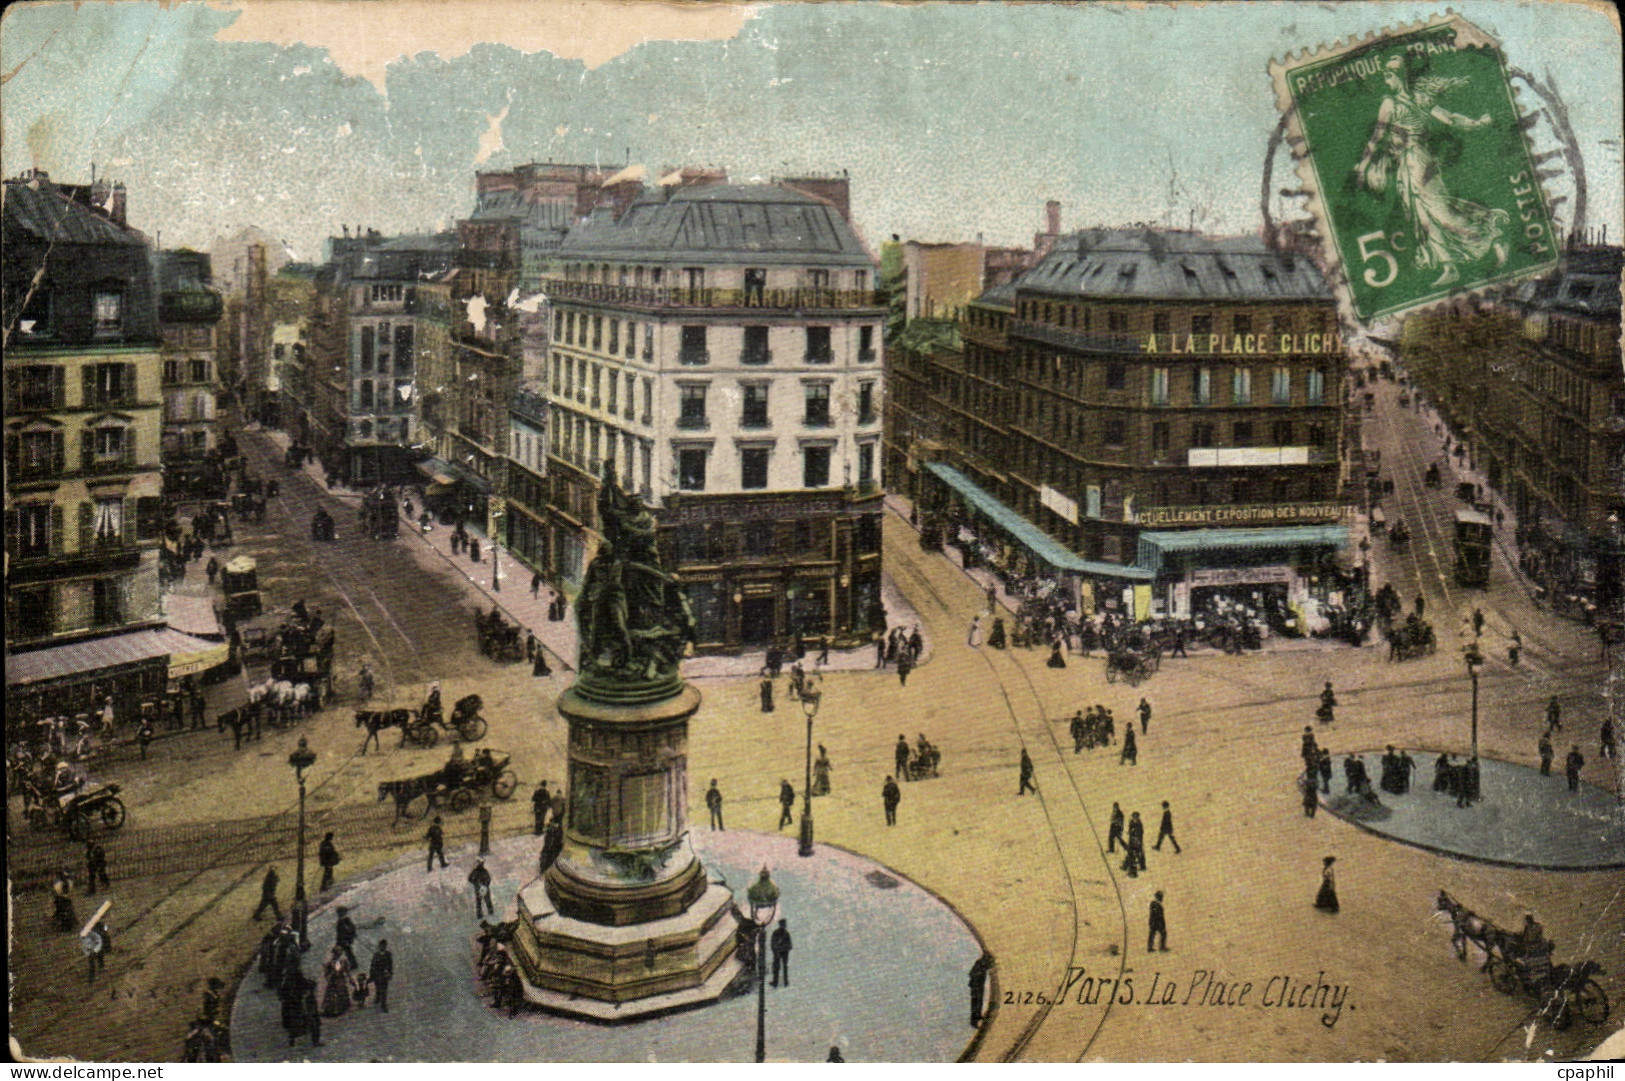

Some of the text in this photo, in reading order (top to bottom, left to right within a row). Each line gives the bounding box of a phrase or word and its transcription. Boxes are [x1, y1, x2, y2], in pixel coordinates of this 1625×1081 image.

[1509, 170, 1549, 256] POSTES
[1171, 335, 1195, 354] LA
[1209, 335, 1267, 354] PLACE
[1281, 334, 1343, 354] CLICHY
[1134, 508, 1212, 524] ACTUELLEMENT
[1216, 508, 1274, 521] EXPOSITION
[1276, 508, 1297, 518] DES
